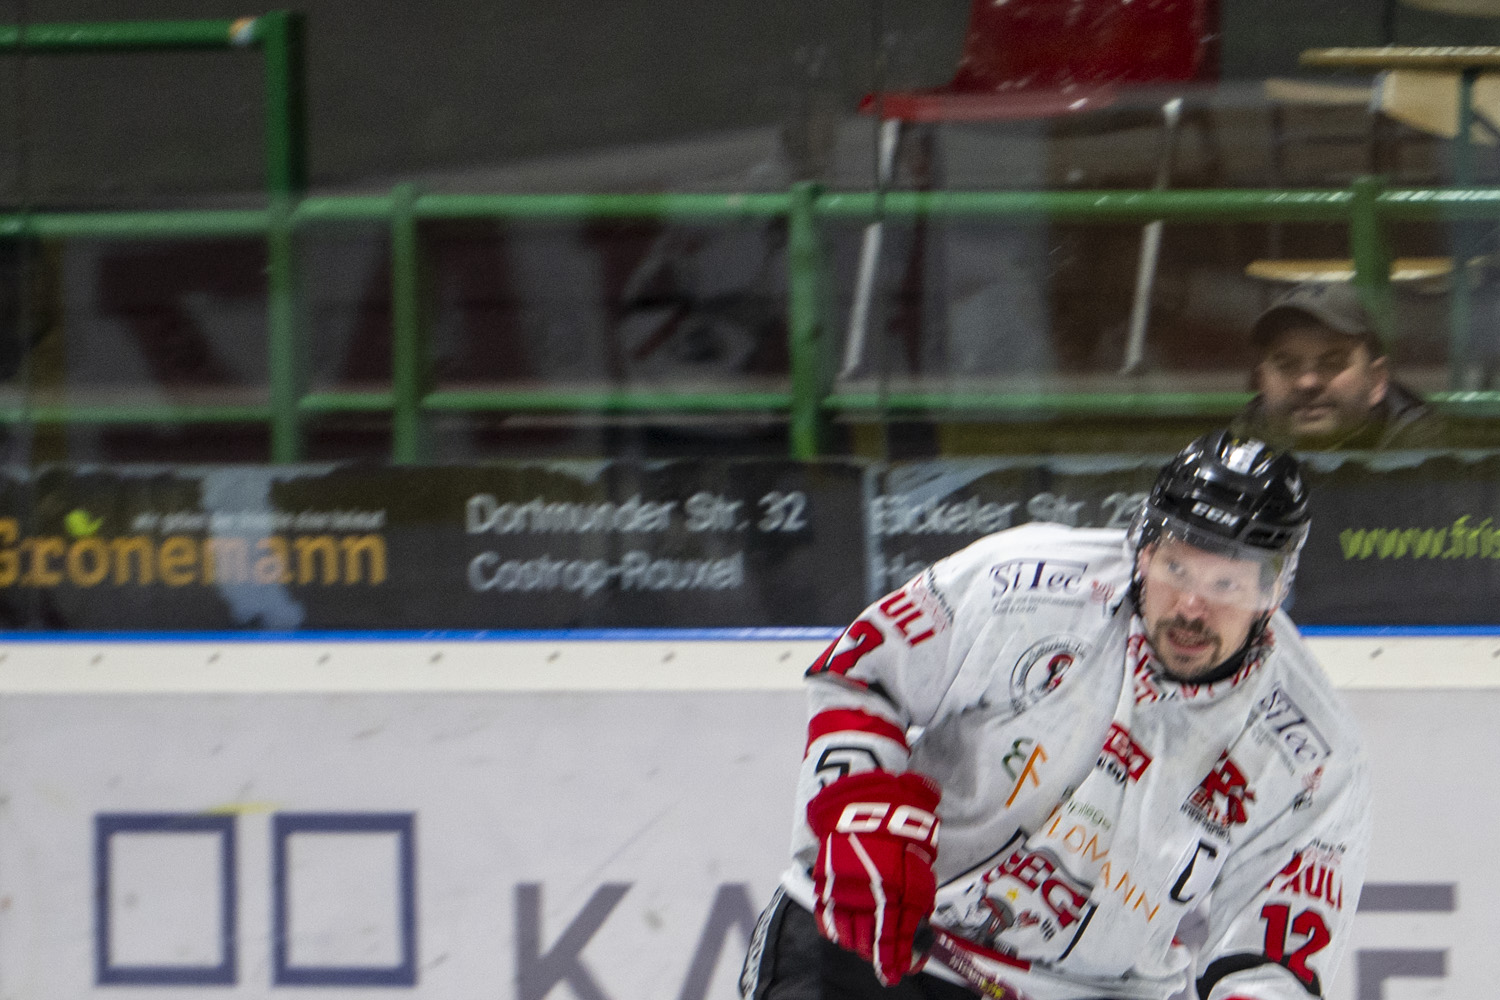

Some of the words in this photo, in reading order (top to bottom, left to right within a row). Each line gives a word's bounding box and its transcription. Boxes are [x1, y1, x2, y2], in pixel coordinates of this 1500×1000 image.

[466, 494, 677, 534] Dortmunder
[684, 491, 749, 532] Str.
[757, 491, 807, 532] 32
[835, 802, 941, 849] CC
[1259, 902, 1332, 986] 12
